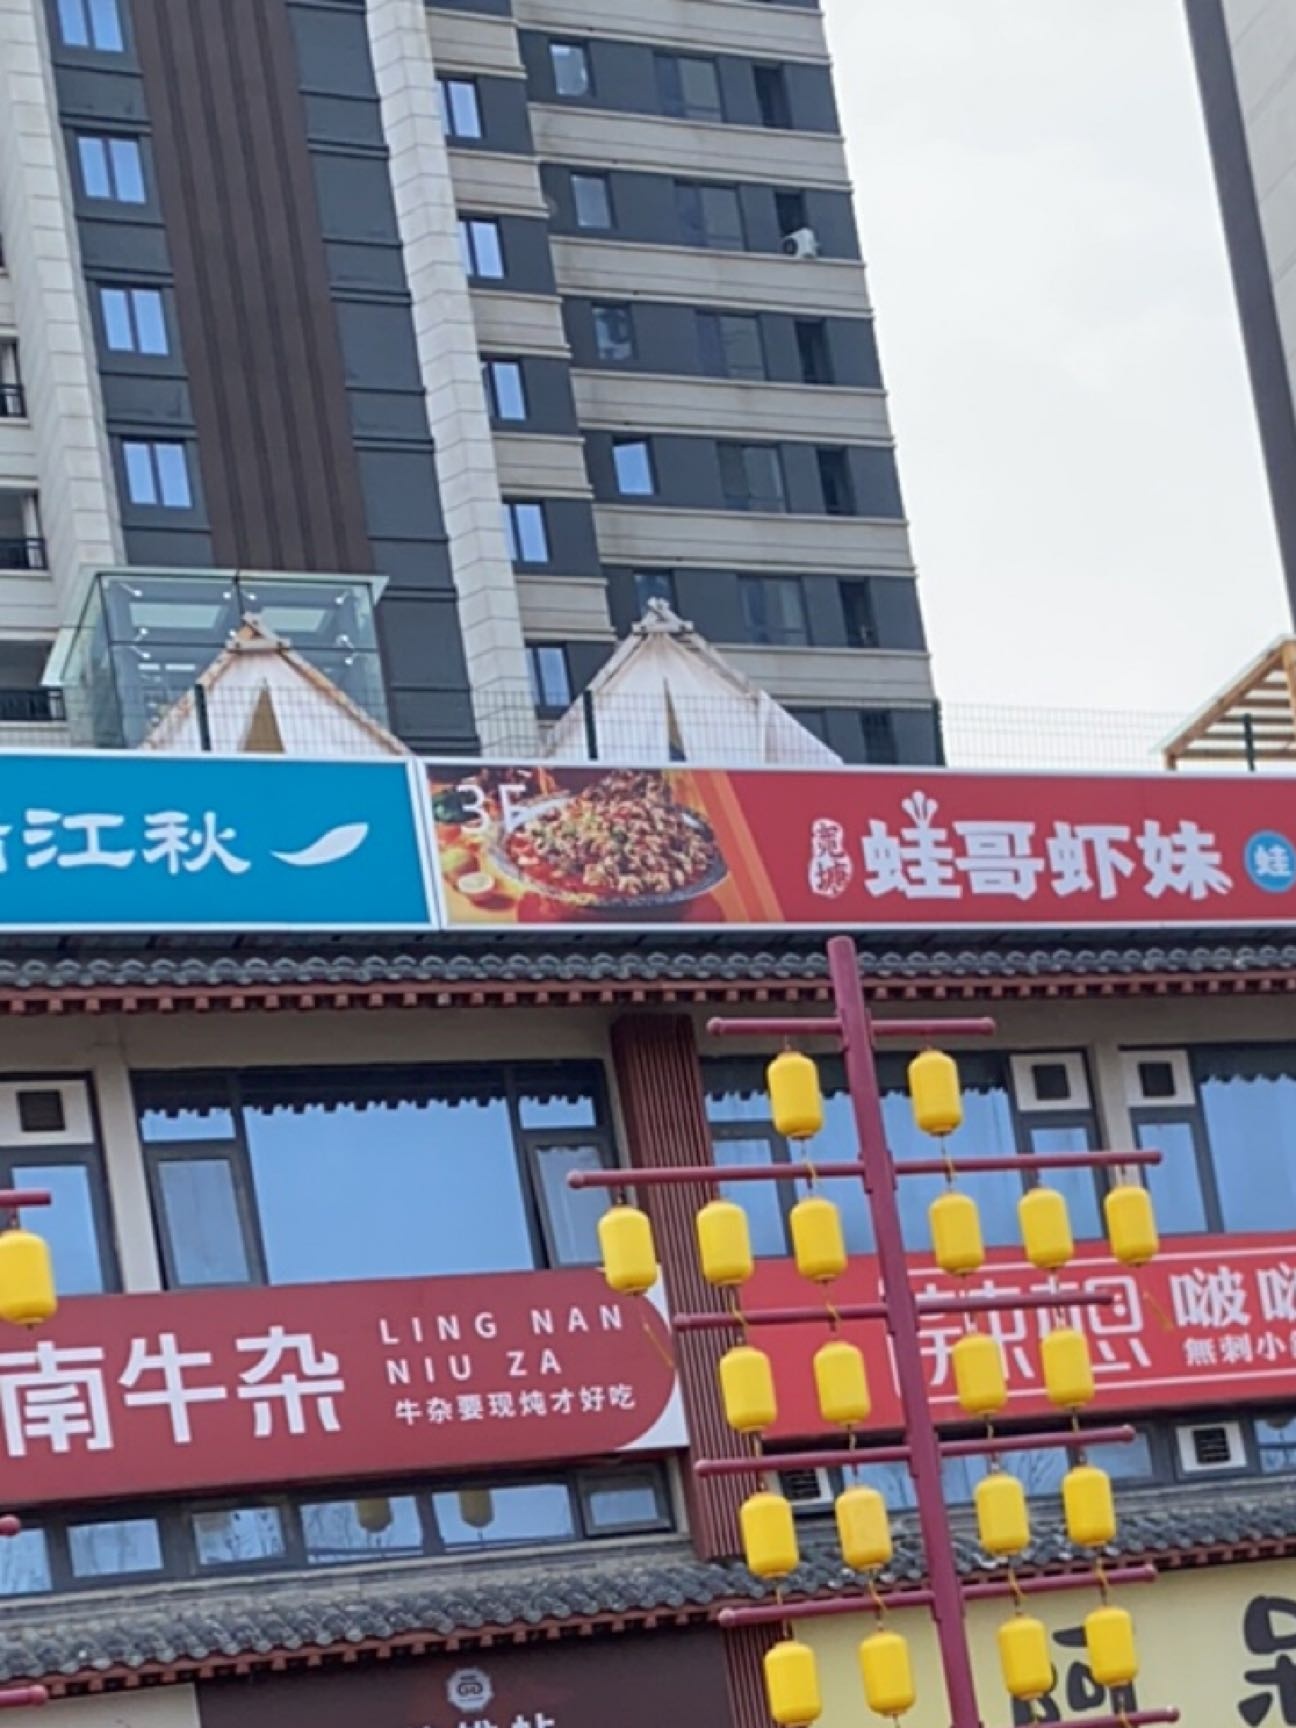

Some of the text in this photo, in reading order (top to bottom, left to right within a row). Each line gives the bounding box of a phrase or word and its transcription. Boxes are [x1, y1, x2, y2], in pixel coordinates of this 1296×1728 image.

[0, 807, 251, 876] 江秋
[860, 818, 1233, 901] 蛙哥虾妹
[378, 1303, 623, 1345] LING NAN
[0, 1325, 345, 1457] 南牛杂
[386, 1347, 562, 1385] NIU ZA
[394, 1382, 636, 1427] 牛杂要现炖才好吃
